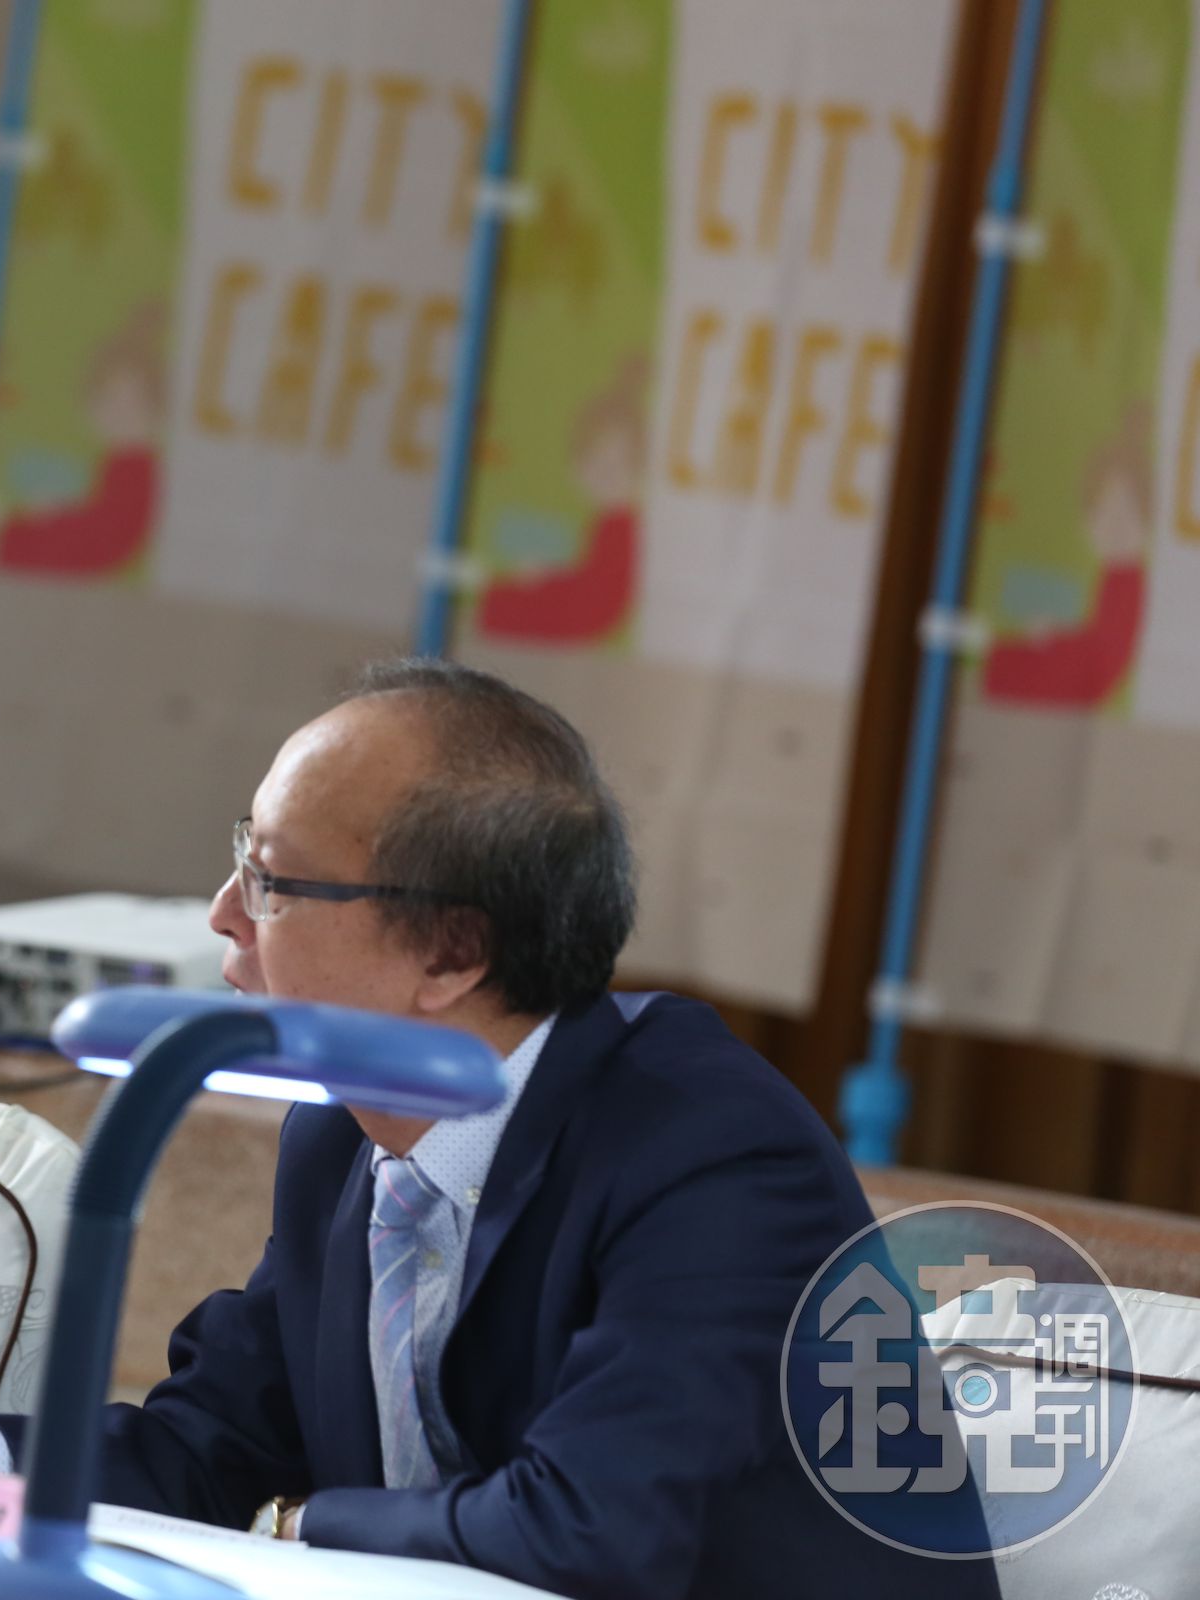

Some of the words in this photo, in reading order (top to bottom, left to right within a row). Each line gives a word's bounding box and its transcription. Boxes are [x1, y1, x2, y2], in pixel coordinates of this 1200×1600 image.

[695, 90, 943, 273] CITY
[194, 264, 460, 471] CAFE
[667, 310, 902, 517] CAFE
